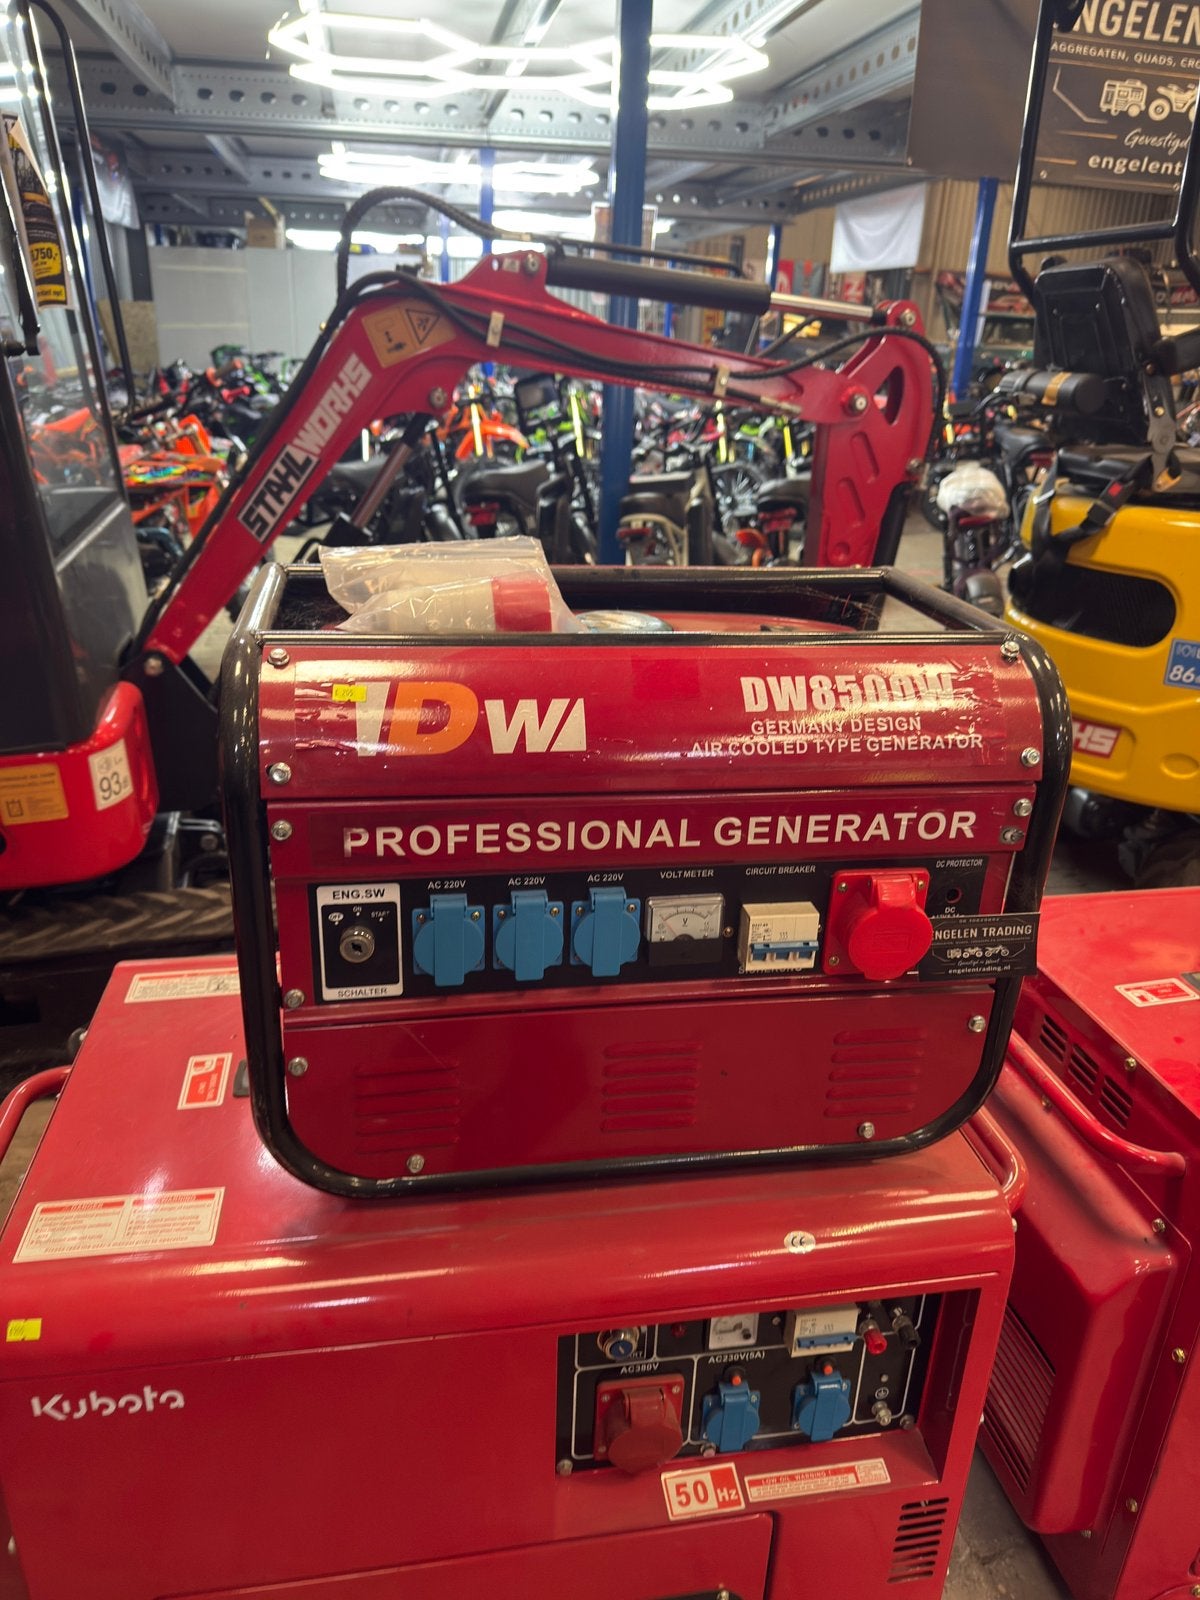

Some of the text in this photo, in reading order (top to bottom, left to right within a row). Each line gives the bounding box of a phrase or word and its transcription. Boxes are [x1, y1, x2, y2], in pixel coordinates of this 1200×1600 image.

[1073, 0, 1200, 46] NGELEN
[1051, 41, 1129, 62] AGGREGATEN,
[1134, 52, 1177, 68] QUADS,
[751, 717, 921, 735] GERMANY DESIGN
[691, 733, 984, 756] AIR COOLED TYPE GENERATOR
[343, 811, 977, 857] PROFESSIONAL GENERATOR
[936, 859, 983, 868] DC PROTECTOR
[745, 865, 816, 876] CIRCUIT BREAKER
[508, 876, 545, 886] AC 220V
[587, 873, 624, 882] AC 220V
[428, 880, 466, 889] AC 220V
[332, 888, 386, 900] ENG.SW
[982, 925, 1033, 937] TRADING
[948, 965, 1011, 975] engelentrading.nl
[338, 987, 388, 998] SCHALTER
[620, 1363, 660, 1375] AC380V
[31, 1385, 185, 1421] Kubota
[675, 1480, 739, 1508] 50 Hz
